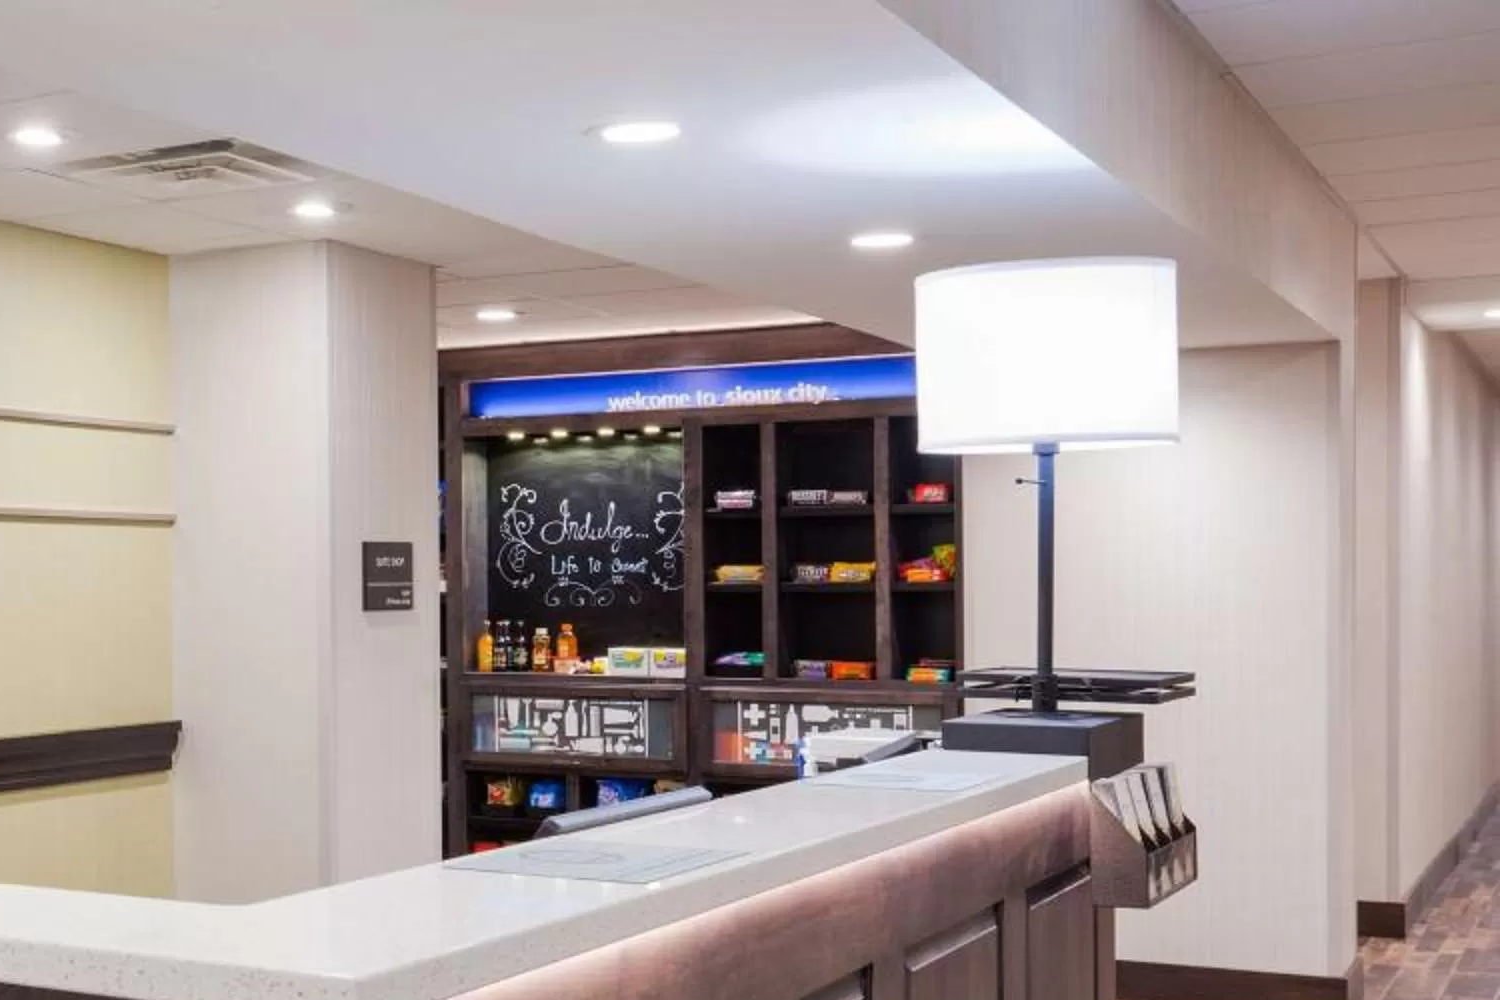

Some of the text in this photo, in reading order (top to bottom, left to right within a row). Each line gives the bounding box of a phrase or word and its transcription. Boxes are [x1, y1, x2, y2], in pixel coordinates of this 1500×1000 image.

[607, 381, 828, 412] welcome to sioux city
